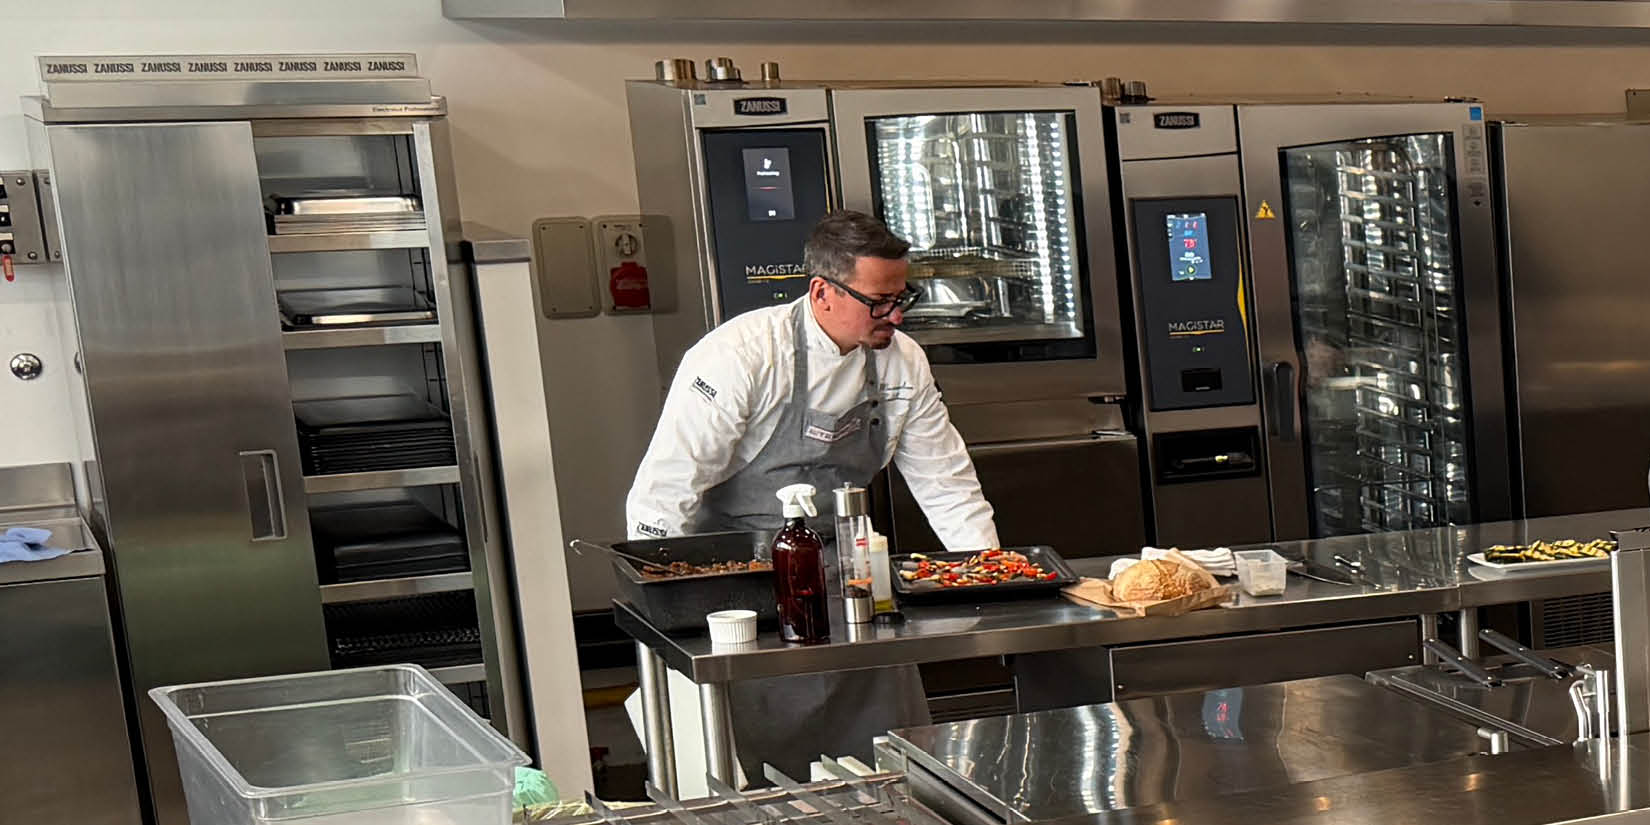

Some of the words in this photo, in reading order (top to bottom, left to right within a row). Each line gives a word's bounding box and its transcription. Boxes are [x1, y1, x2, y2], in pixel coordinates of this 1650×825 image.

[46, 64, 88, 74] ZANUSSI
[94, 63, 134, 74] ZANUSSI
[141, 62, 181, 73] ZANUSSI
[188, 62, 227, 72] ZANUSSI
[234, 62, 272, 72] ZANUSSI
[278, 62, 317, 72] ZANUSSI
[323, 62, 362, 71] ZANUSSI
[368, 61, 405, 70] ZANUSSI
[740, 100, 781, 112] ZANUSSI
